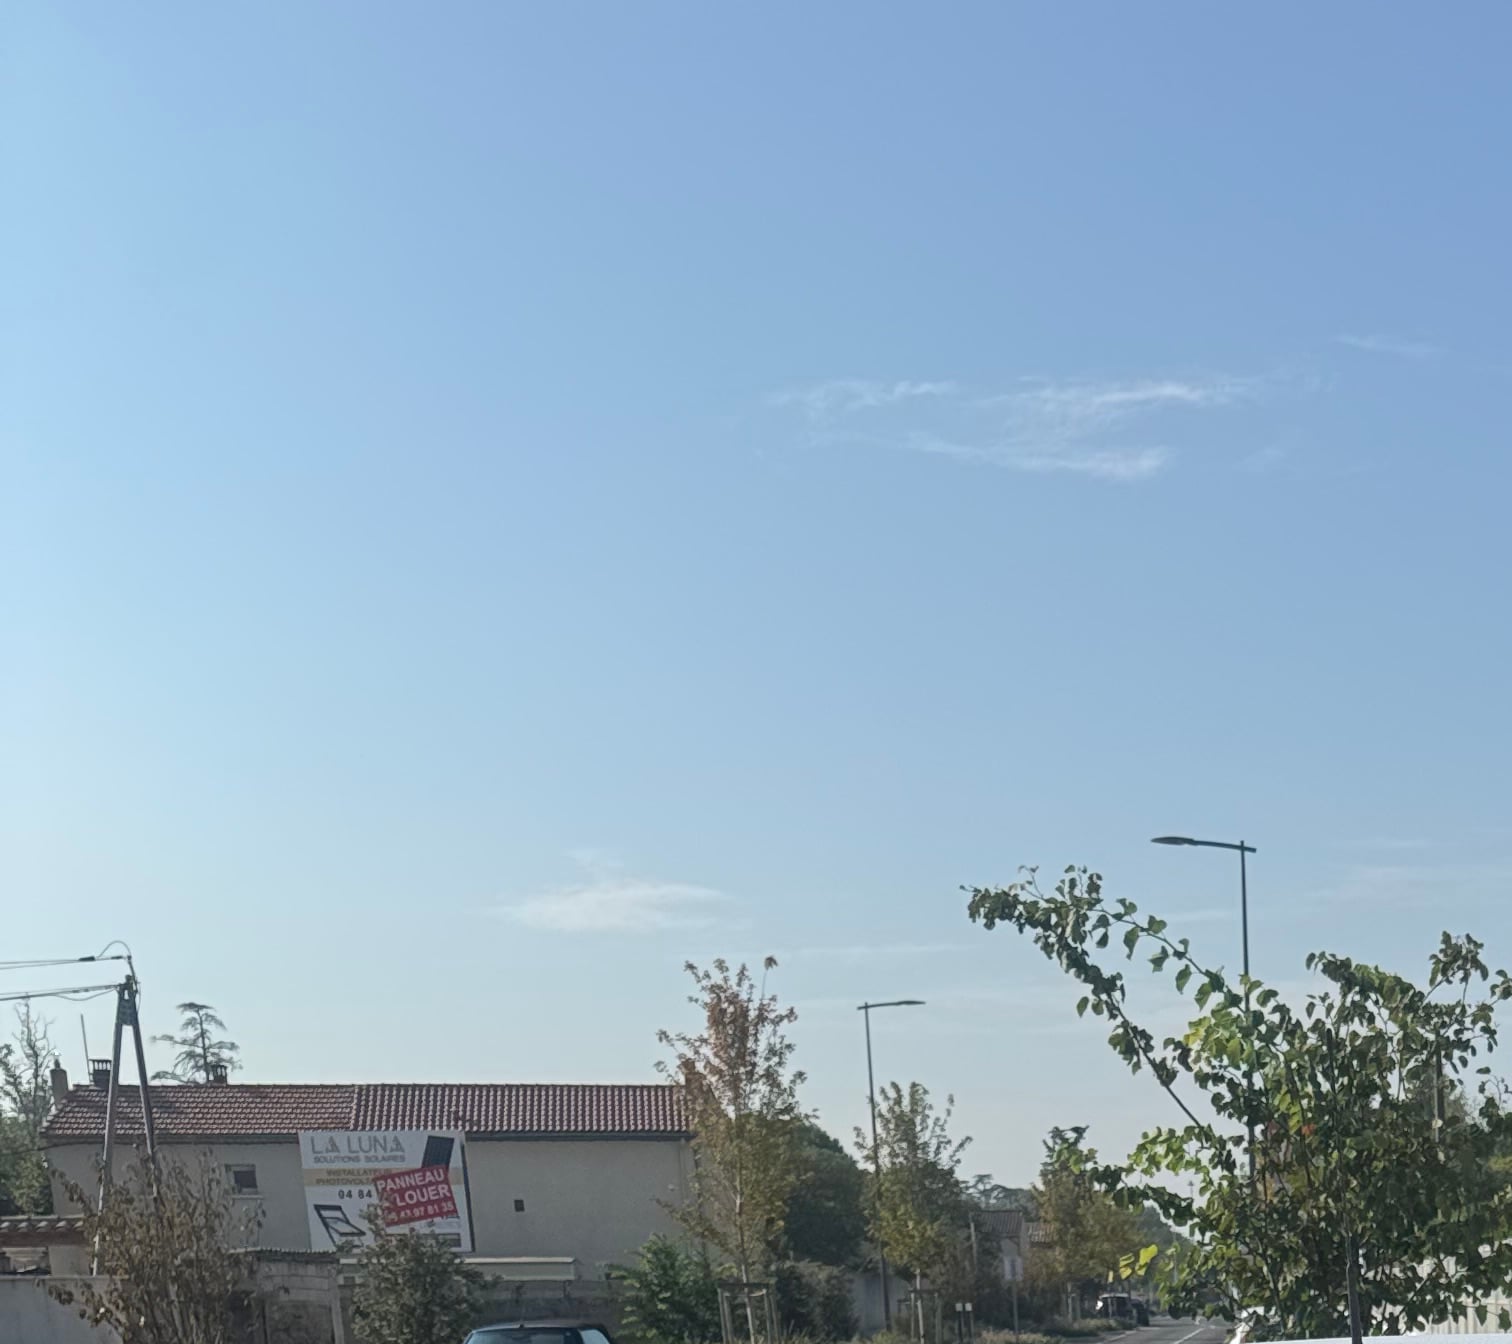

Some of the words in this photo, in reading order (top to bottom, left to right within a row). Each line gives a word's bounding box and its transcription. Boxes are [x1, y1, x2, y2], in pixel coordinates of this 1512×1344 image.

[310, 1136, 340, 1154] LA
[347, 1135, 405, 1154] LUNA
[376, 1169, 445, 1191] PANNEAU
[338, 1189, 352, 1199] 04
[395, 1184, 451, 1207] LOUER
